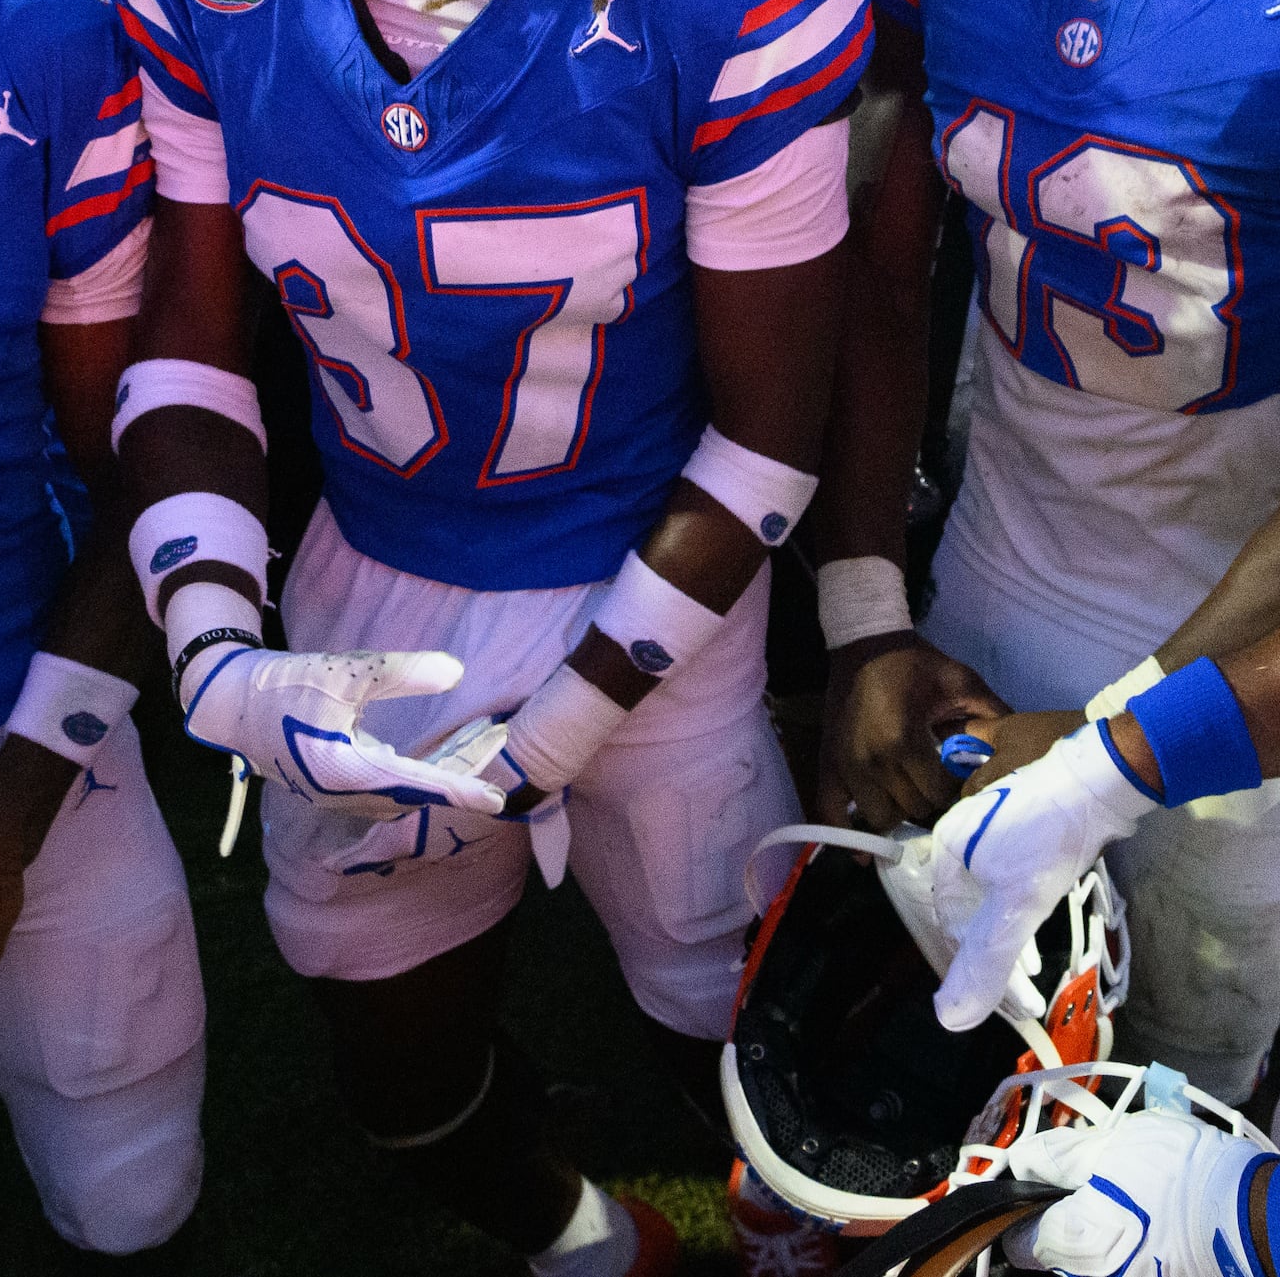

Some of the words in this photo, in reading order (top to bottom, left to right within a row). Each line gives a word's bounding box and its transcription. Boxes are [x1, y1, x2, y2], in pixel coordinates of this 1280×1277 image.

[1059, 21, 1099, 65] SEC
[384, 106, 425, 149] SEC
[941, 99, 1242, 416] 13
